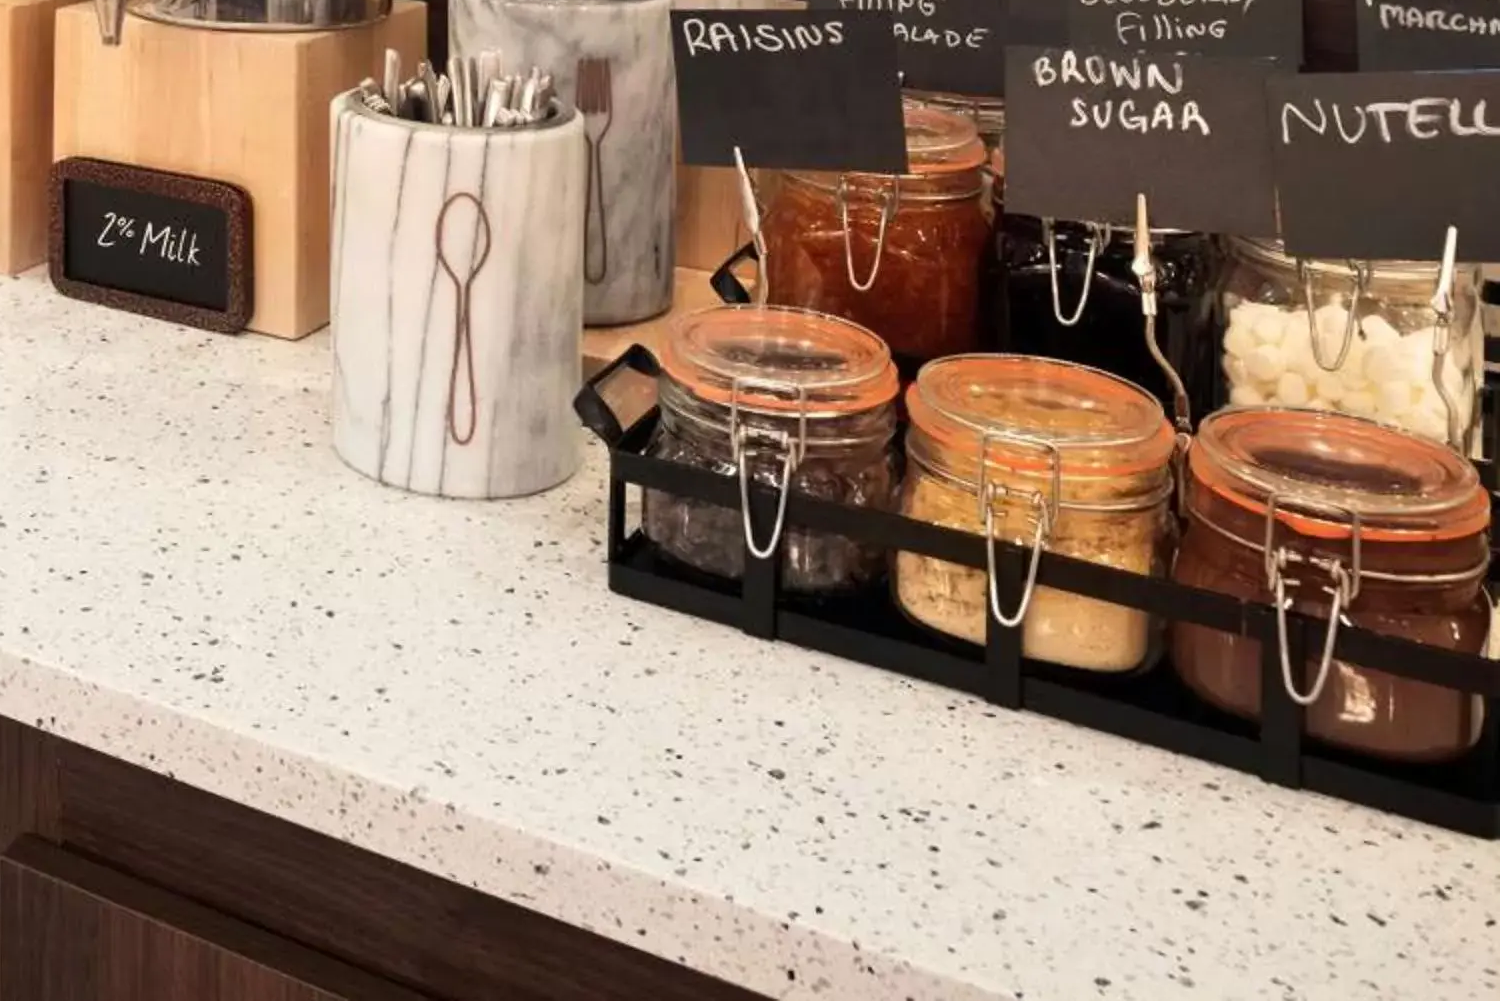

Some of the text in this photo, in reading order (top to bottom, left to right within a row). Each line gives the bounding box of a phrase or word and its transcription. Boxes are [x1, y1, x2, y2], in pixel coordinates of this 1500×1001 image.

[683, 17, 845, 57] RAISINS
[1032, 50, 1184, 95] BROWN
[1069, 98, 1211, 136] SUGAR
[1281, 96, 1500, 145] NUTELL
[97, 211, 202, 267] 2% Milk
